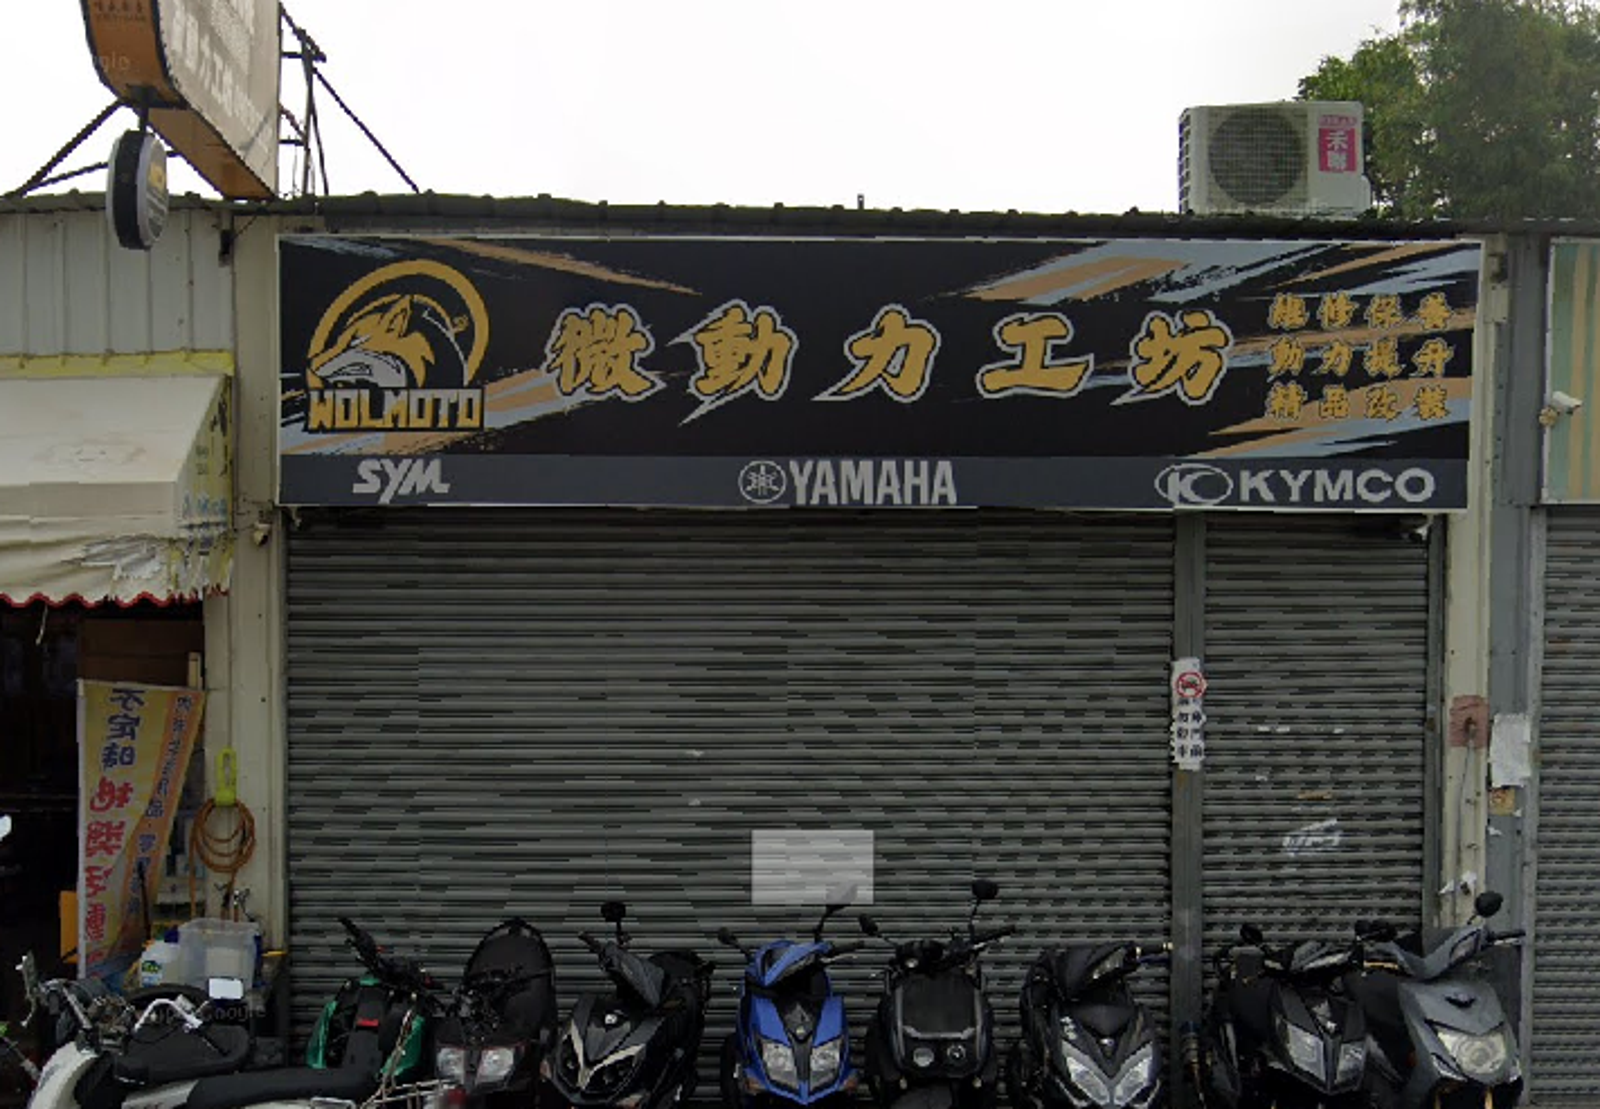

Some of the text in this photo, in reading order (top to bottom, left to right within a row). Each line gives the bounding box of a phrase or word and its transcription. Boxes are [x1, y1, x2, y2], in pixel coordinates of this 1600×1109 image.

[544, 299, 1233, 410] 微動力工坊
[307, 388, 483, 430] WOLMOTO
[352, 458, 450, 504] SYM
[789, 459, 957, 505] YAMAHA
[1239, 467, 1436, 502] KYMCO
